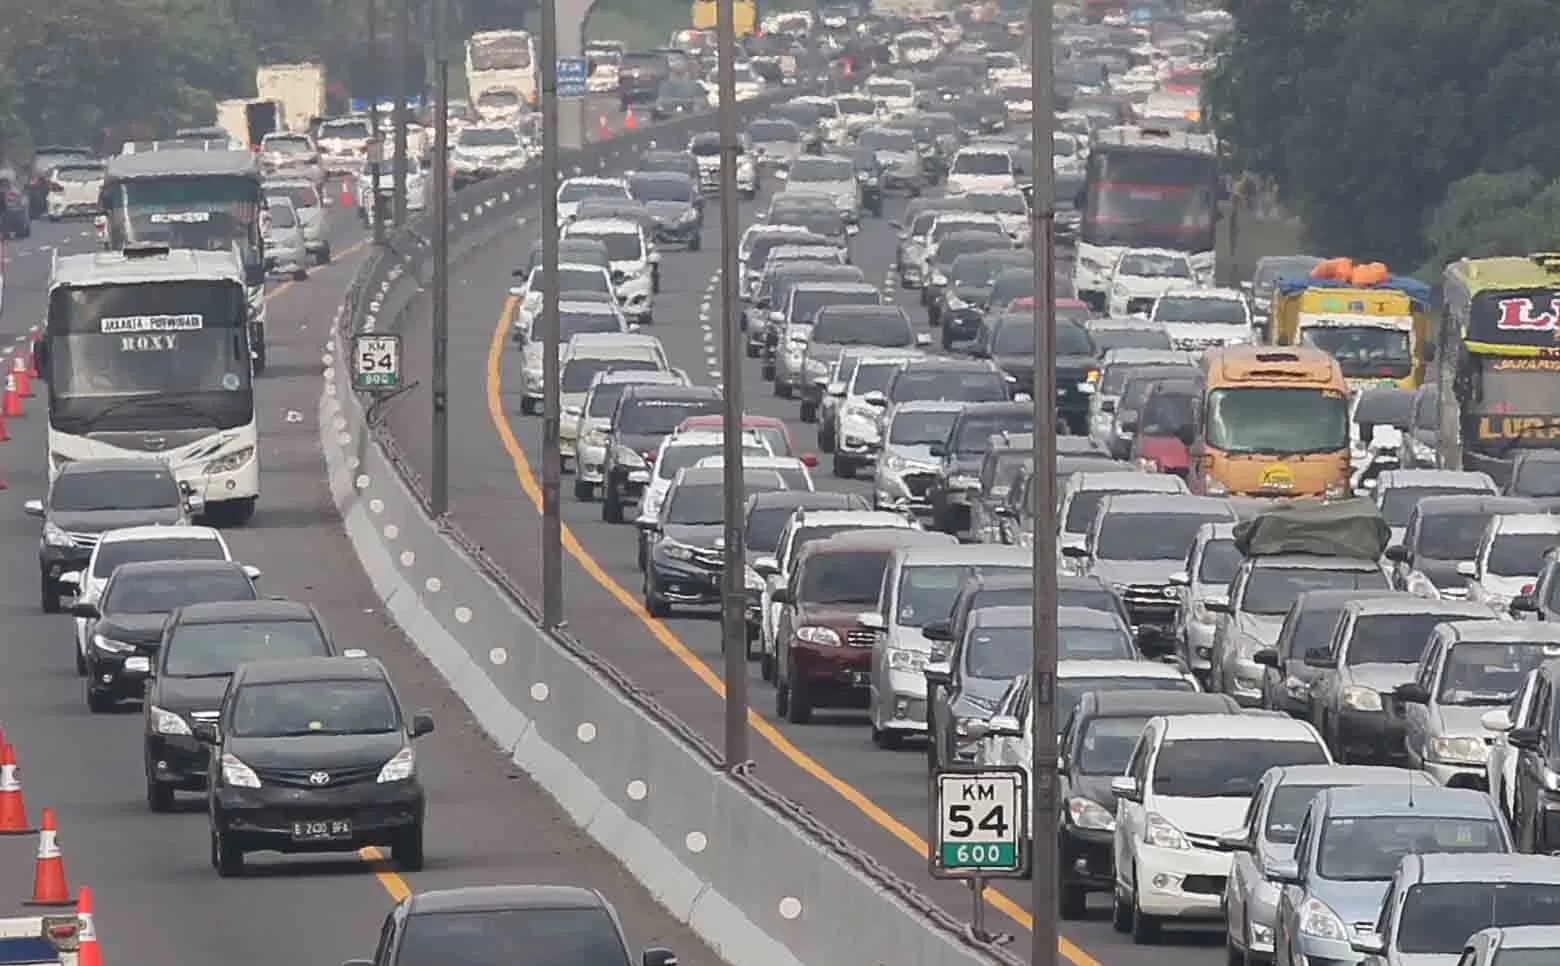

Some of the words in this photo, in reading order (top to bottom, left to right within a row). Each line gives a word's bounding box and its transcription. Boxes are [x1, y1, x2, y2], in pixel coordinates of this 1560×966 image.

[120, 334, 176, 352] ROXY
[362, 353, 392, 370] 54
[962, 783, 995, 800] KM
[949, 804, 1008, 838] 54
[957, 844, 1000, 862] 600
